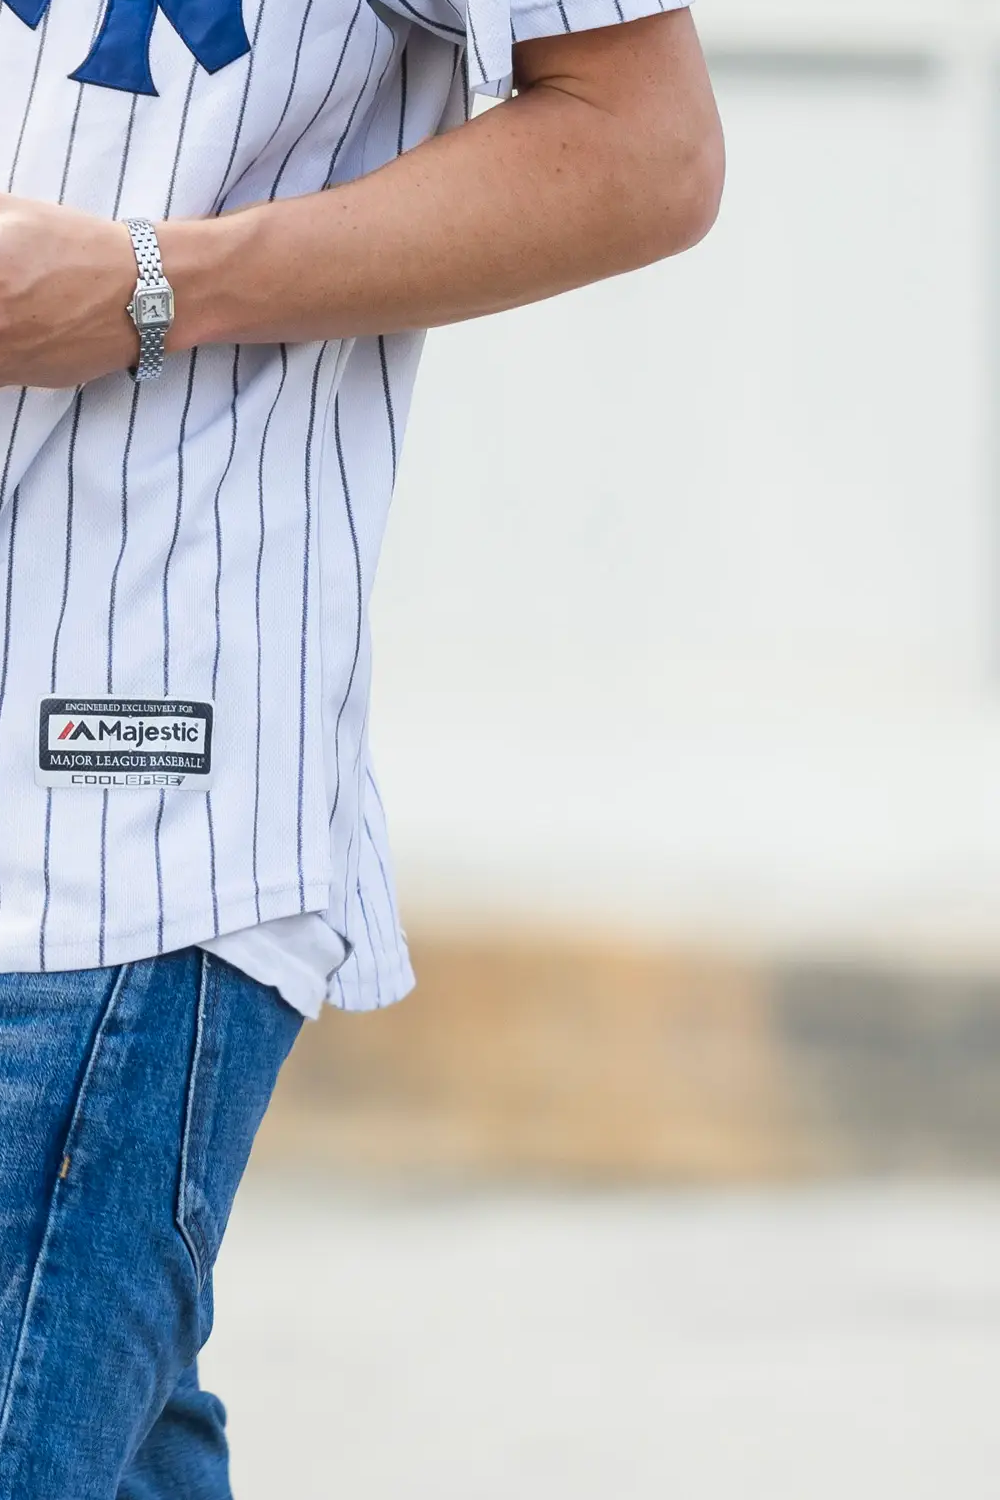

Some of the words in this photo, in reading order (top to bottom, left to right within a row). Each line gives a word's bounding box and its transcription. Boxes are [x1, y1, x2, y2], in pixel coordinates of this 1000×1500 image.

[65, 702, 120, 712] ENGINEERED
[121, 703, 176, 713] EXCLUSIVELY
[179, 705, 193, 713] FOR
[99, 719, 199, 748] Majestic
[50, 754, 92, 768] MAJOR
[95, 755, 147, 768] LEAGUE
[150, 755, 203, 769] BASEBALL
